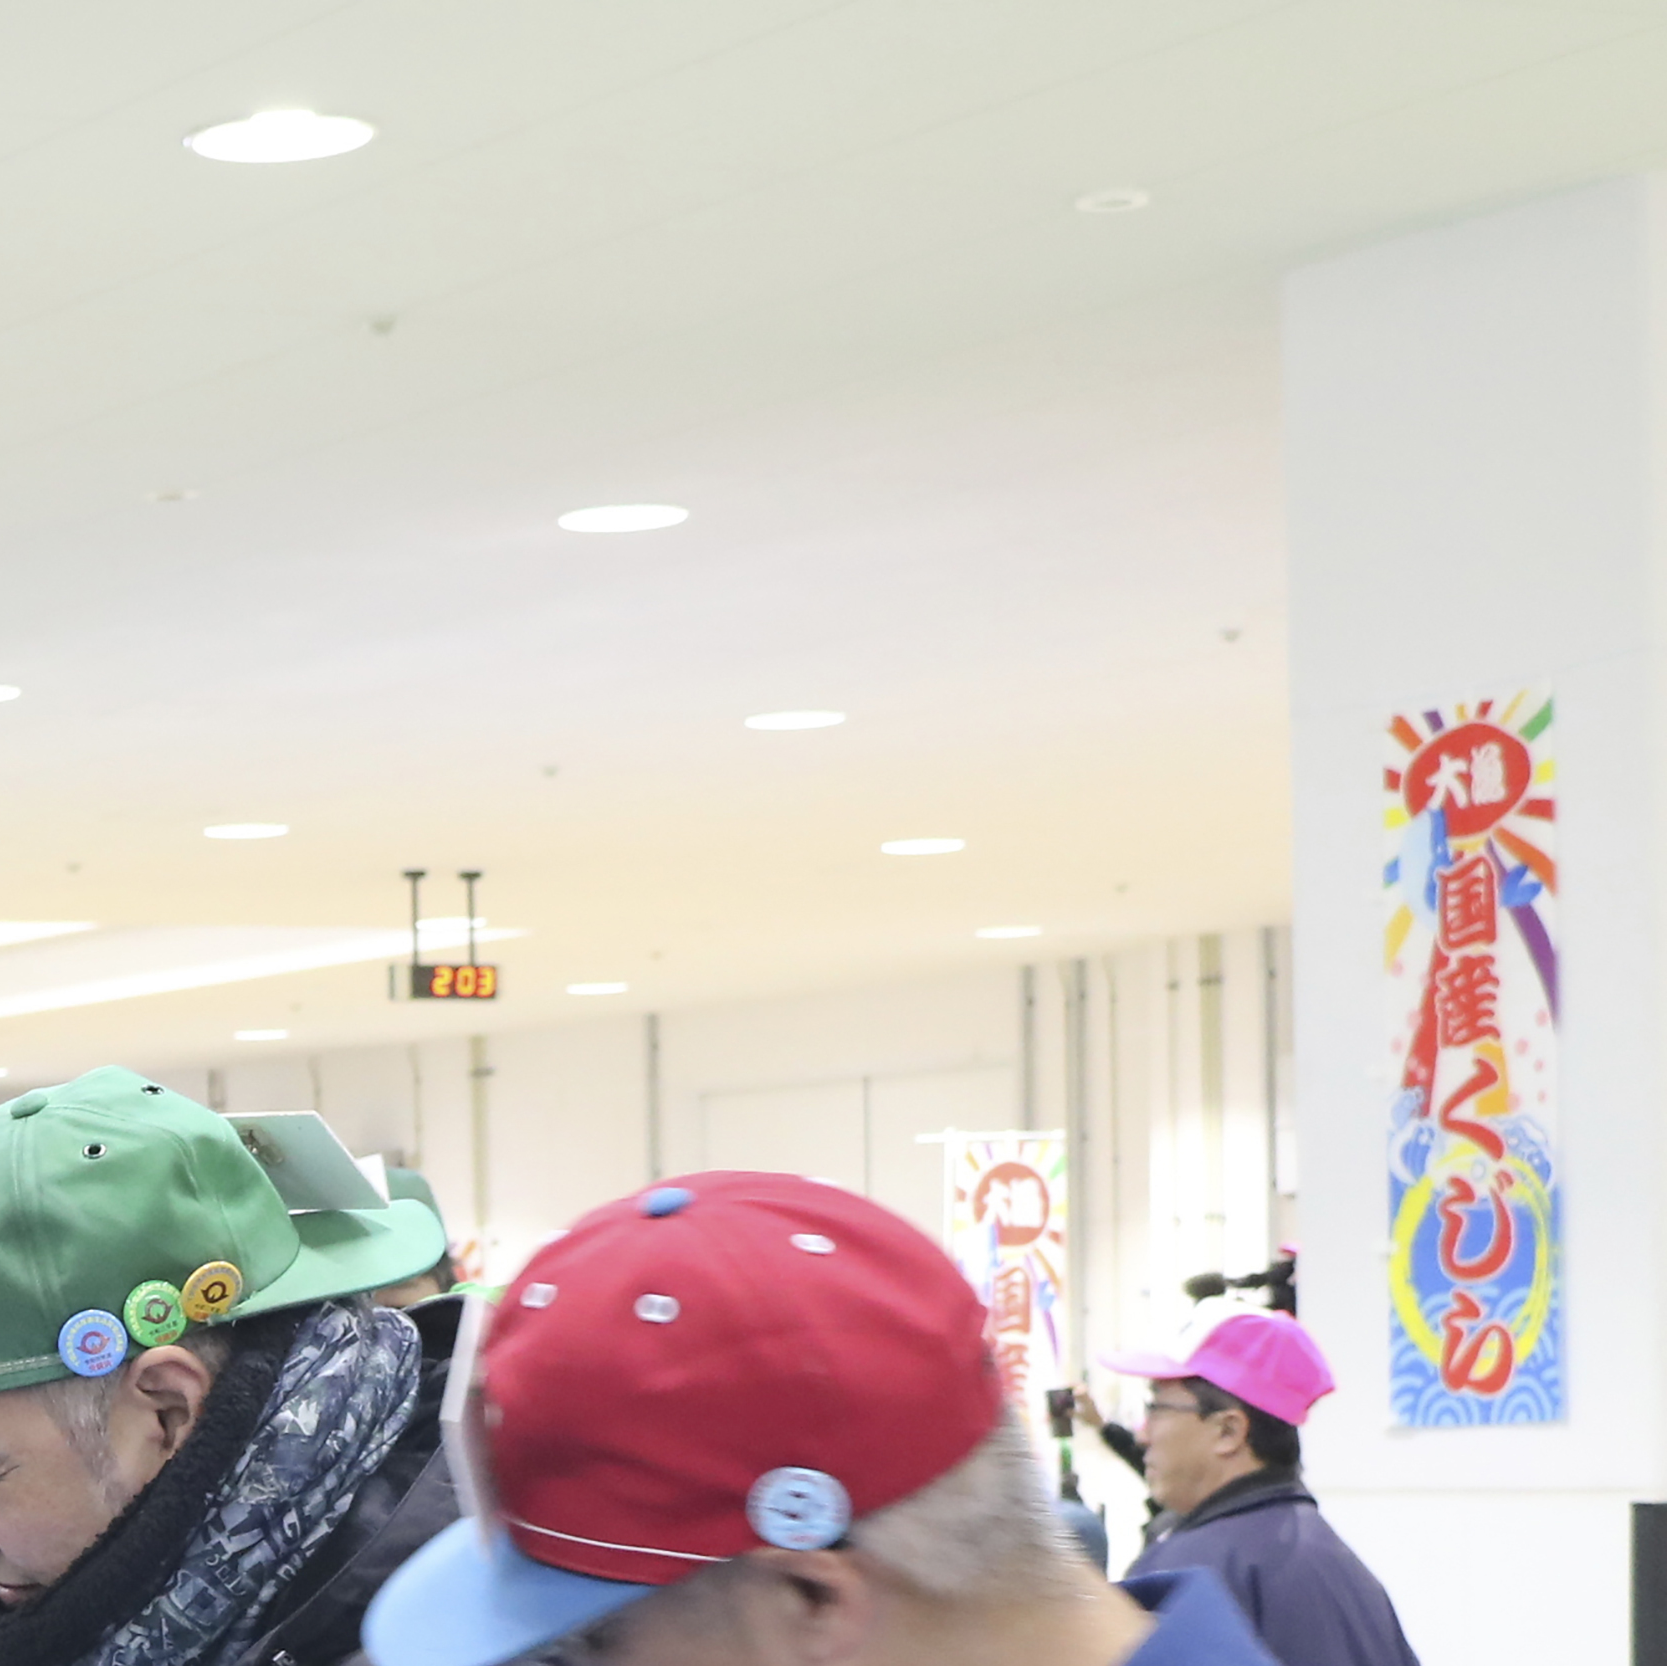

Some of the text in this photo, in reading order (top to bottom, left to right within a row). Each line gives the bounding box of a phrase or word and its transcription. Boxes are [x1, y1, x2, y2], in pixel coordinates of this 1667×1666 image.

[1436, 854, 1514, 1397] 国産くじら
